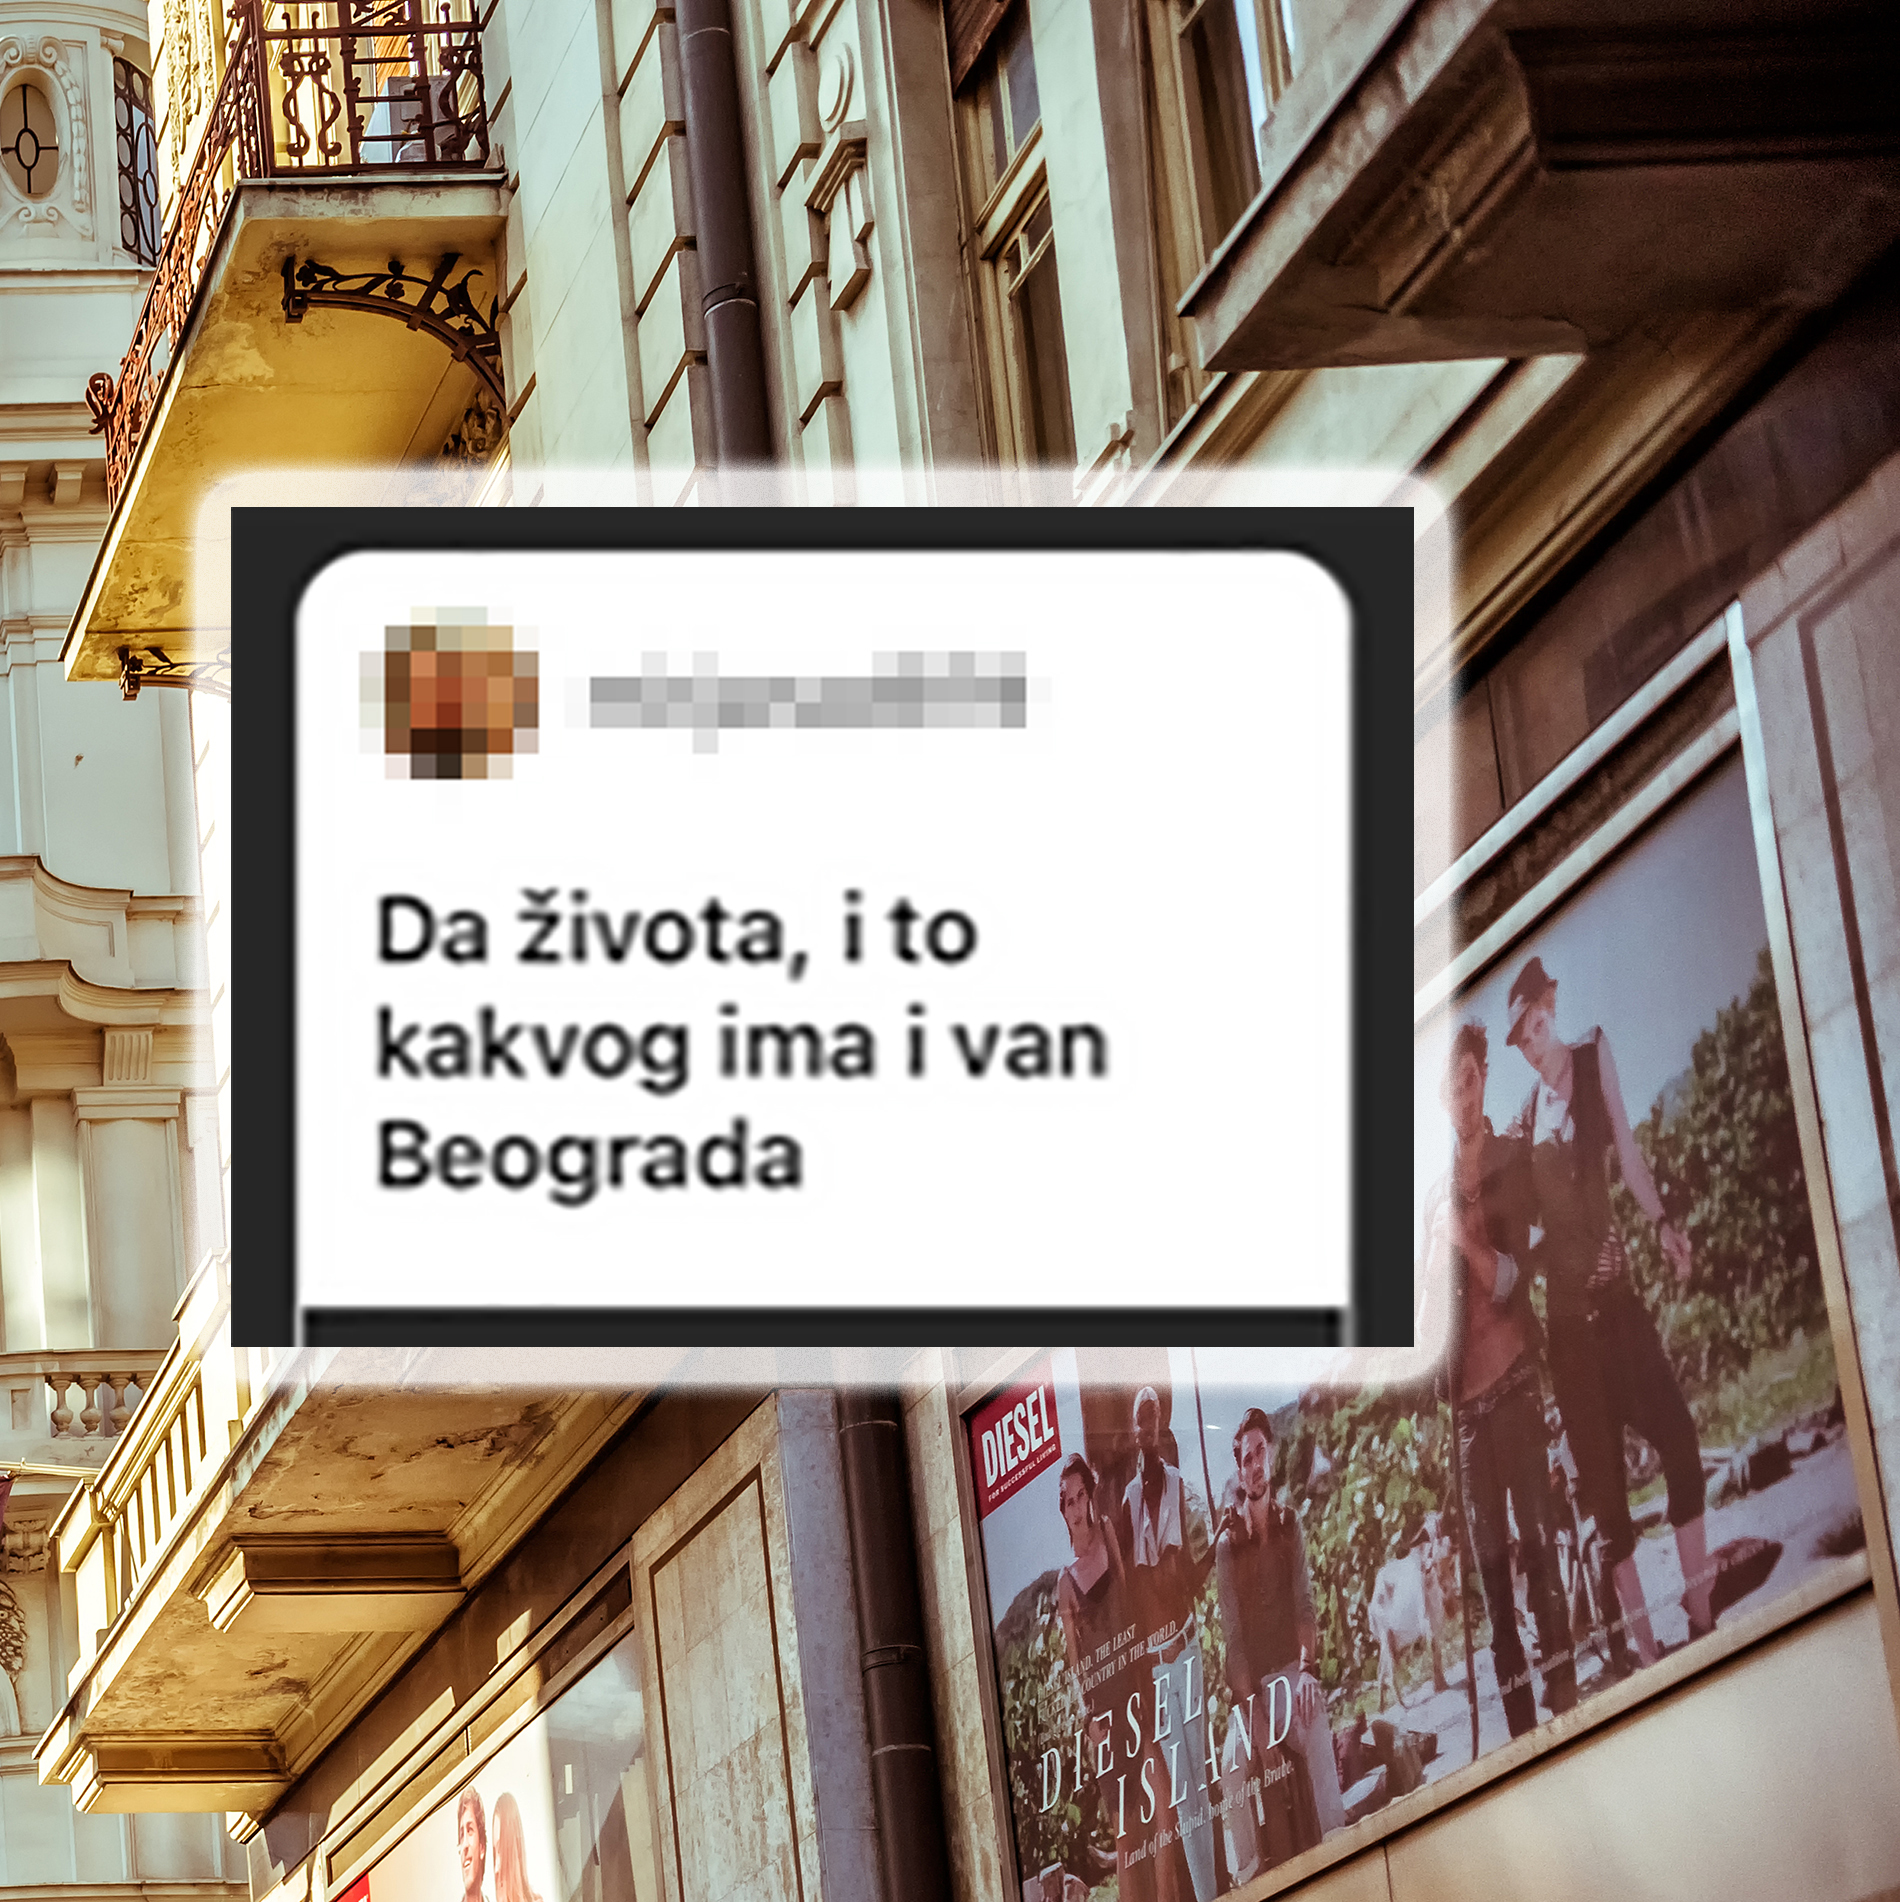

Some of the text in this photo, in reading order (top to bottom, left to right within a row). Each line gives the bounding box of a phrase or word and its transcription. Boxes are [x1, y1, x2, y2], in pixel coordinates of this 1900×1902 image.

[982, 1385, 1054, 1488] DIESEL
[1082, 1659, 1117, 1695] COUNTRY
[1130, 1640, 1145, 1663] THE
[1096, 1640, 1111, 1663] THE
[1113, 1623, 1137, 1652] LEAST
[1039, 1655, 1202, 1814] DIESEL
[1116, 1674, 1293, 1839] ISLAND
